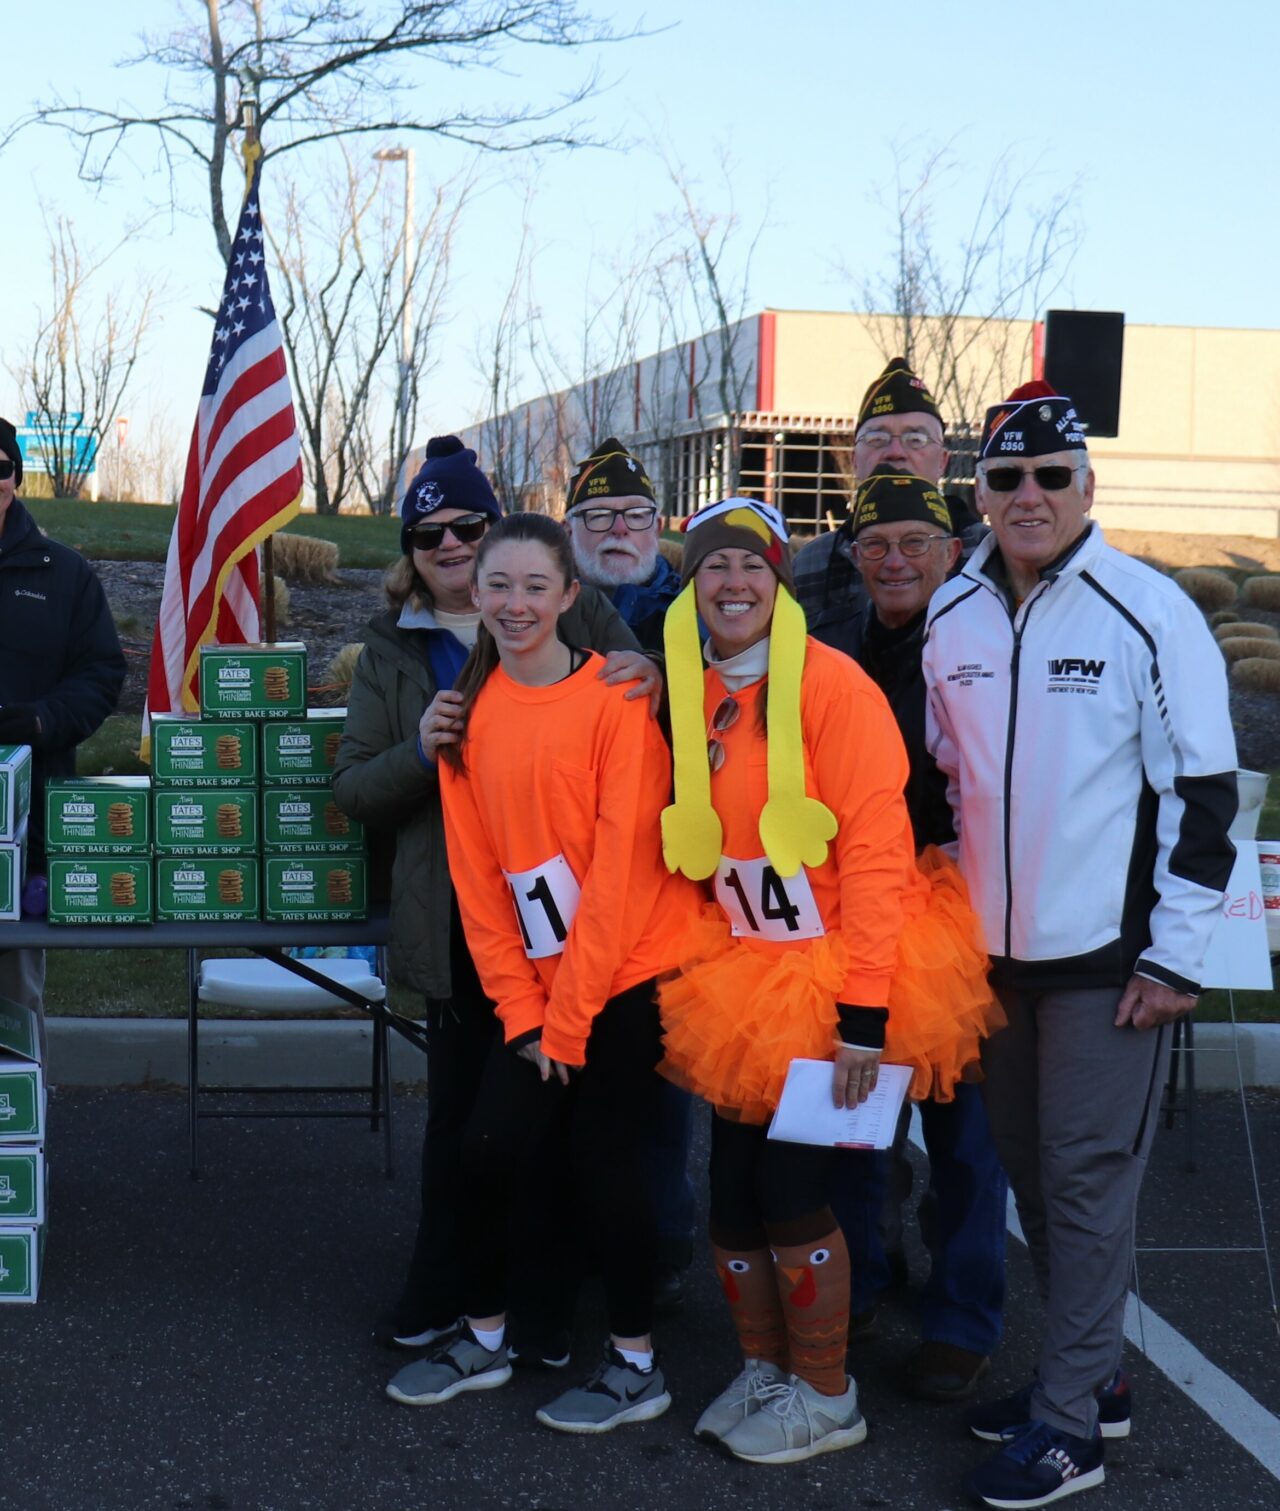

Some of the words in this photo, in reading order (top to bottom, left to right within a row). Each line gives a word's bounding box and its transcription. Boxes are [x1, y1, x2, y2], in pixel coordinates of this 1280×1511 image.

[1003, 431, 1023, 441] VFW
[1000, 441, 1025, 451] 5350
[1048, 659, 1106, 678] VFW
[63, 845, 85, 853] TATE'S
[89, 845, 109, 853] BAKE
[112, 845, 132, 853] SHOP
[724, 865, 800, 931] 14
[223, 912, 243, 920] SHOP
[331, 912, 351, 920] SHOP
